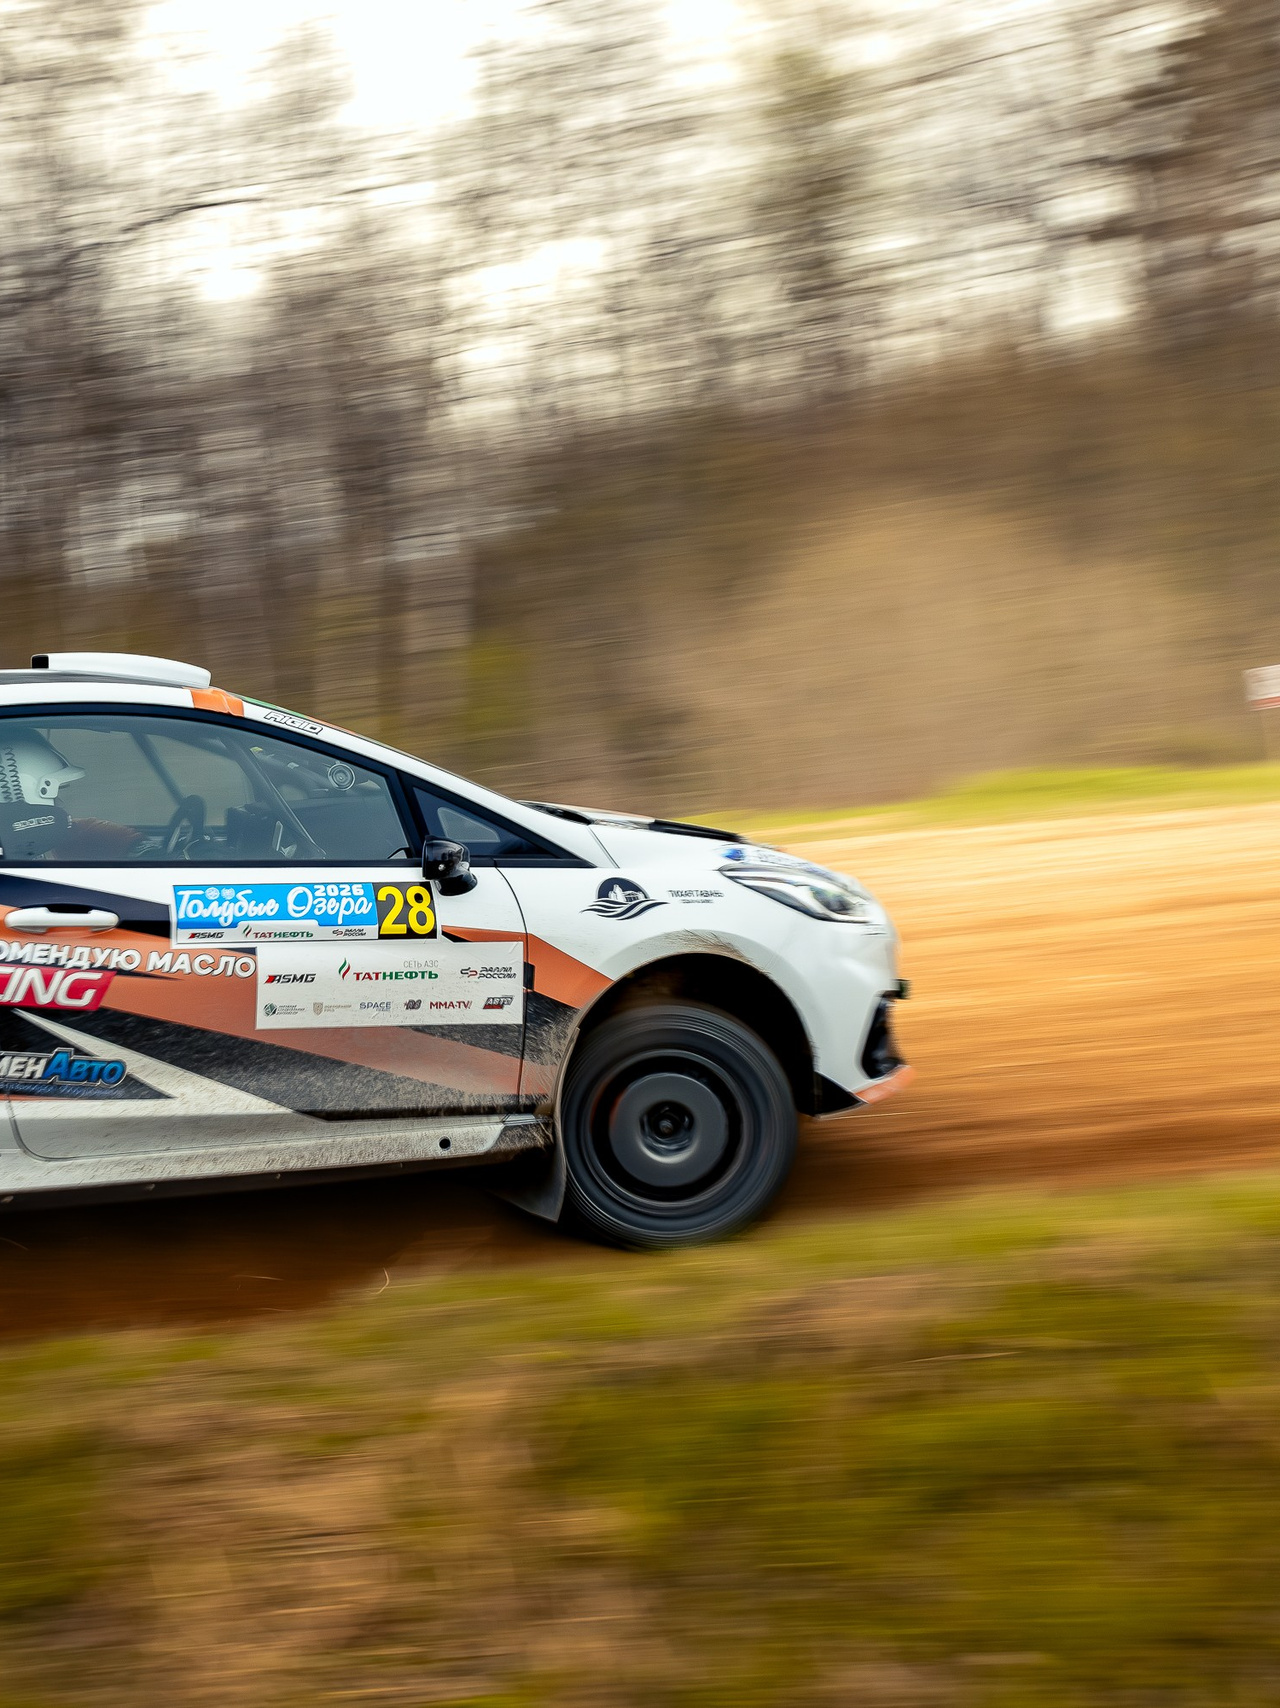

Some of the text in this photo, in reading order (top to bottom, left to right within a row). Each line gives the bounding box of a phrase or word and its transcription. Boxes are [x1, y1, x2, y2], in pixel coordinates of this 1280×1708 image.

[263, 711, 324, 735] RIGID
[313, 884, 364, 897] 2026
[177, 888, 280, 927] Голубые
[377, 885, 436, 935] 28
[253, 931, 314, 939] ТАТНЕФТЬ
[146, 951, 256, 977] МАСЛО
[403, 960, 439, 968] СЕТЬ АЗС
[353, 970, 439, 981] ТАТНЕФТЬ
[359, 1001, 391, 1009] SPACE
